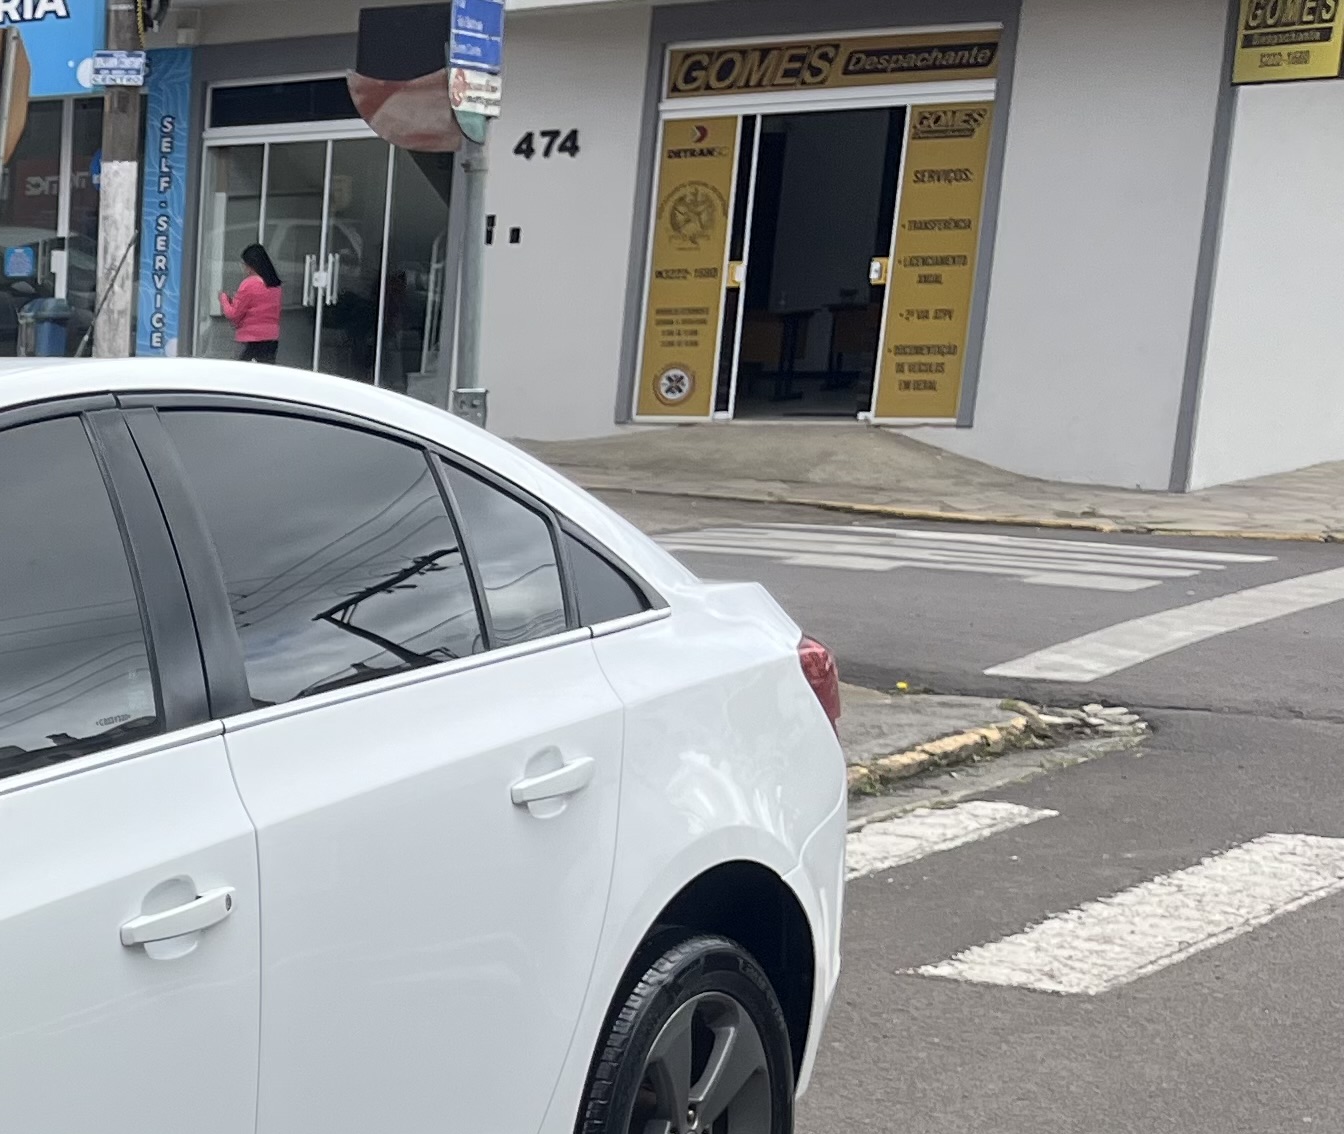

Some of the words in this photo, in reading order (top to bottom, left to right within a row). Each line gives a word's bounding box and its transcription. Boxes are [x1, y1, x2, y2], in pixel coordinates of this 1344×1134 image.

[674, 44, 838, 93] GOMES
[848, 45, 991, 74] Despachante
[513, 128, 581, 160] 474
